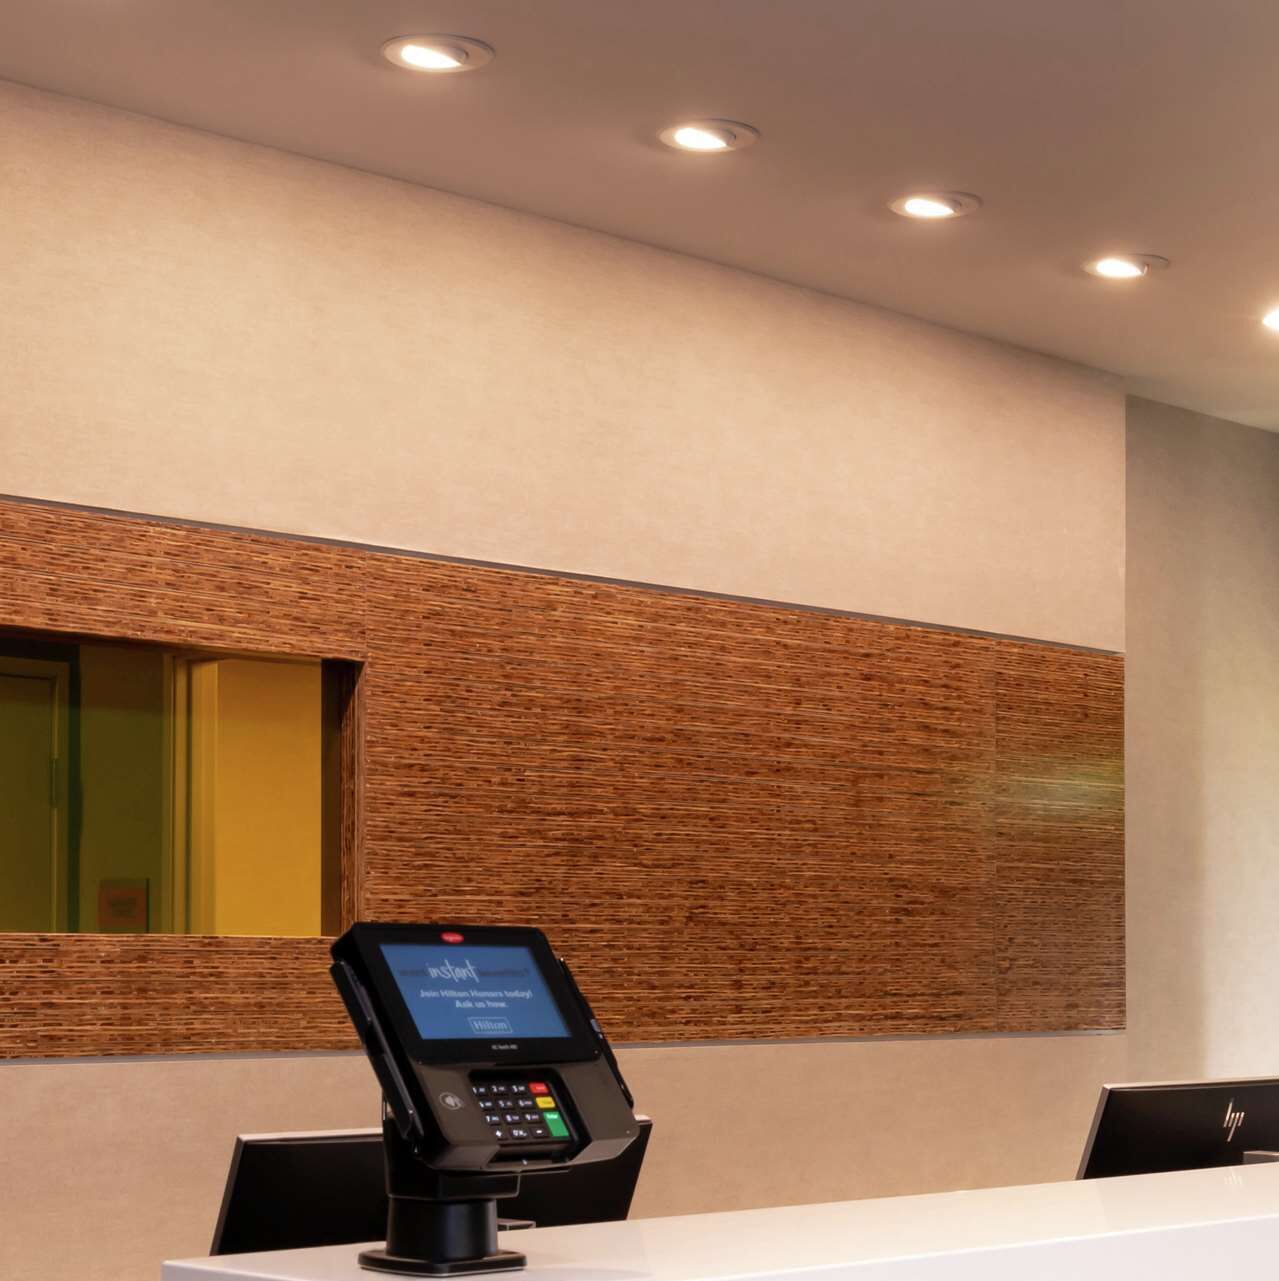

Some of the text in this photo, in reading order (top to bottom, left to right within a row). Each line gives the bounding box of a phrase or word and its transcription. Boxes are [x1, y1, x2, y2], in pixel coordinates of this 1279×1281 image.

[425, 959, 480, 983] instant
[473, 1019, 508, 1031] Hilton
[1223, 1099, 1245, 1142] hp
